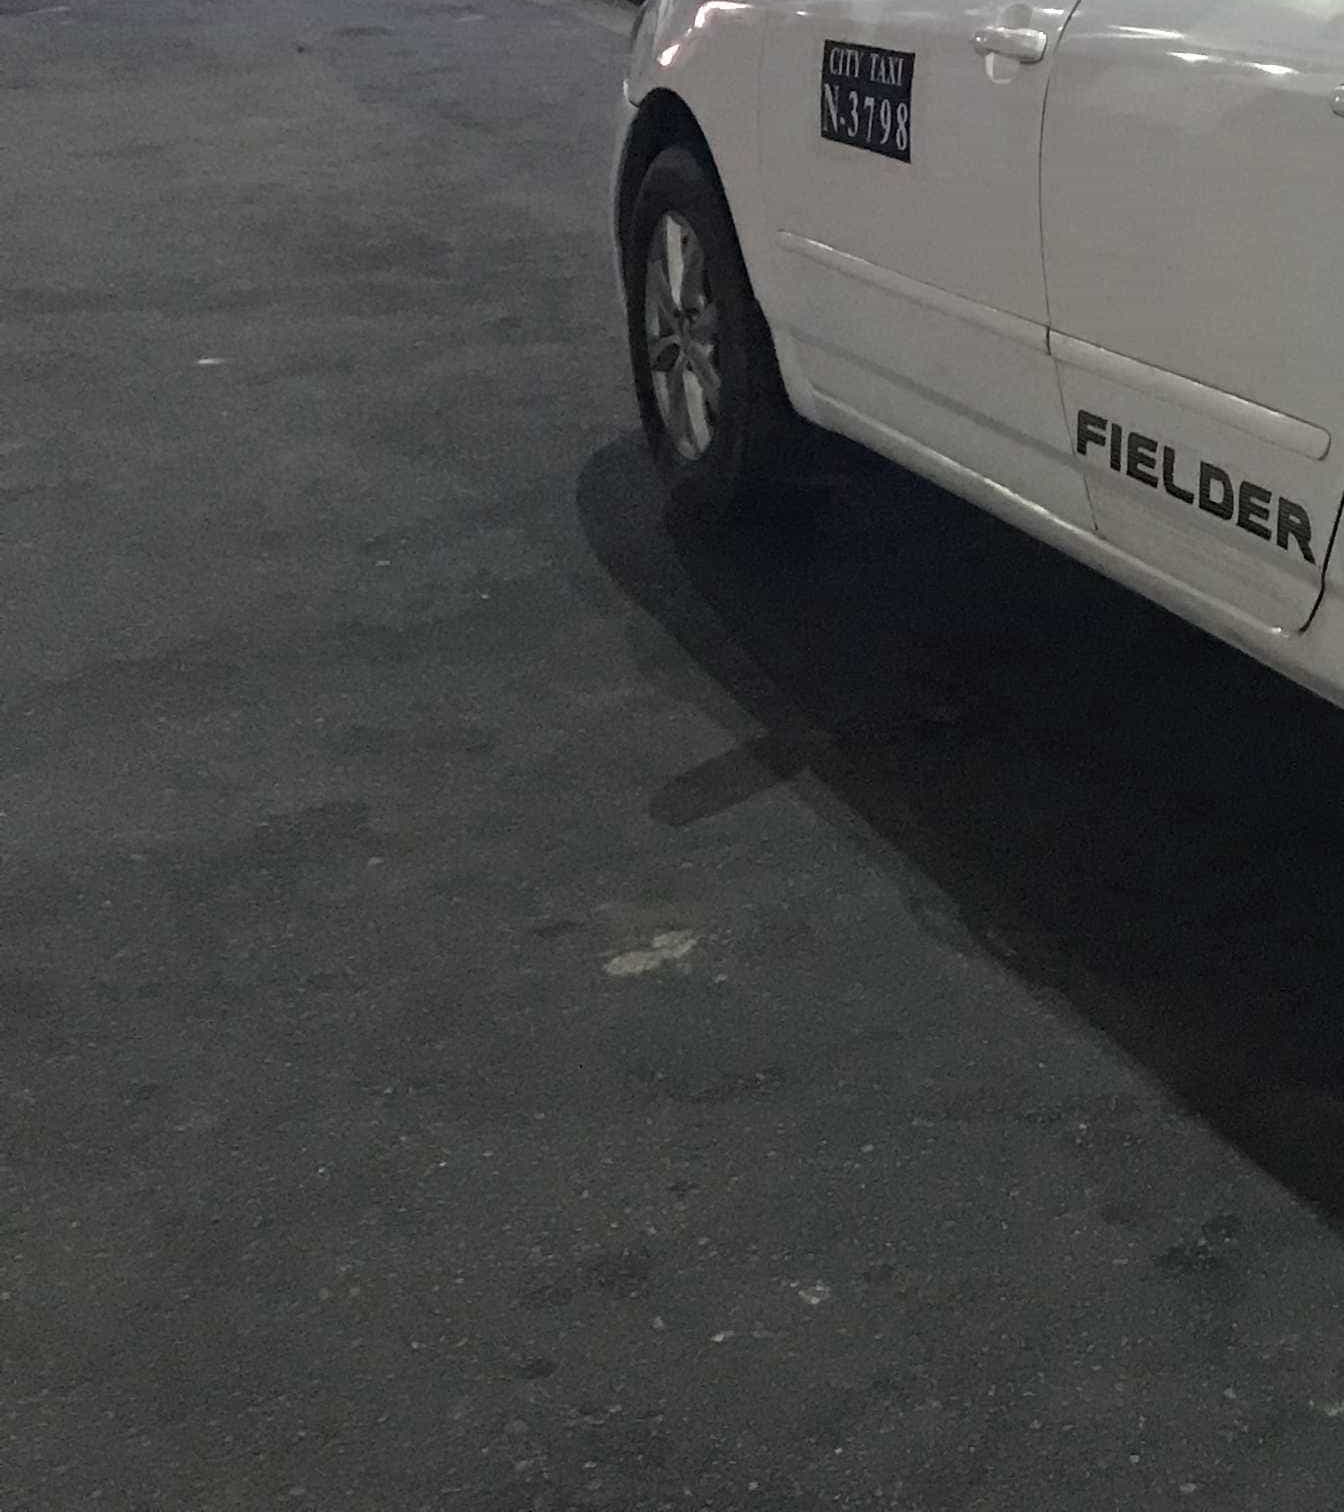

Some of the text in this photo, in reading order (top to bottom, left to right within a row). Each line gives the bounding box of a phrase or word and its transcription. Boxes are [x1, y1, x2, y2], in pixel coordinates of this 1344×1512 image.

[830, 48, 904, 86] CITY TAXI
[1077, 409, 1317, 565] FIELDER
